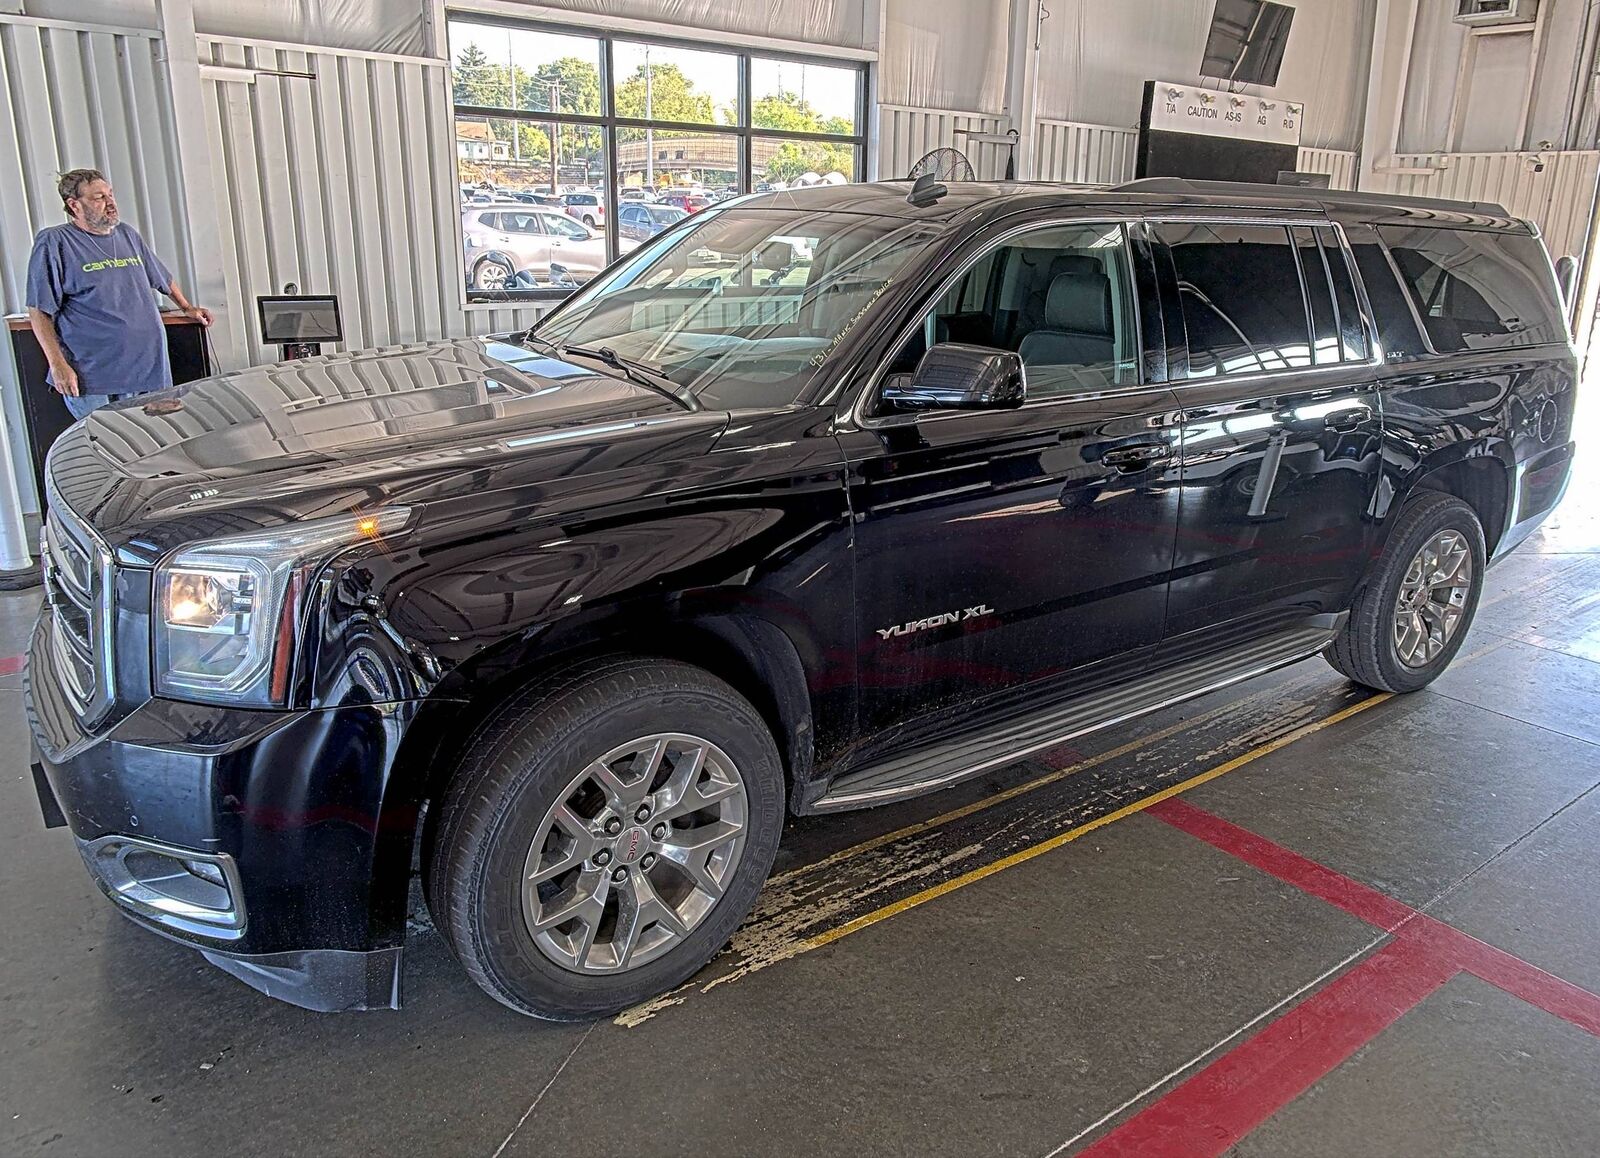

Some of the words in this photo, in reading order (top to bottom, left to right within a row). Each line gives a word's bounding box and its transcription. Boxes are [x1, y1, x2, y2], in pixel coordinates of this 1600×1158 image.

[1187, 105, 1218, 119] CAUTION
[1224, 111, 1242, 122] AS-IS
[1257, 115, 1267, 125] AG
[876, 611, 960, 640] YUKON
[962, 604, 995, 620] XL
[627, 830, 640, 861] GMC
